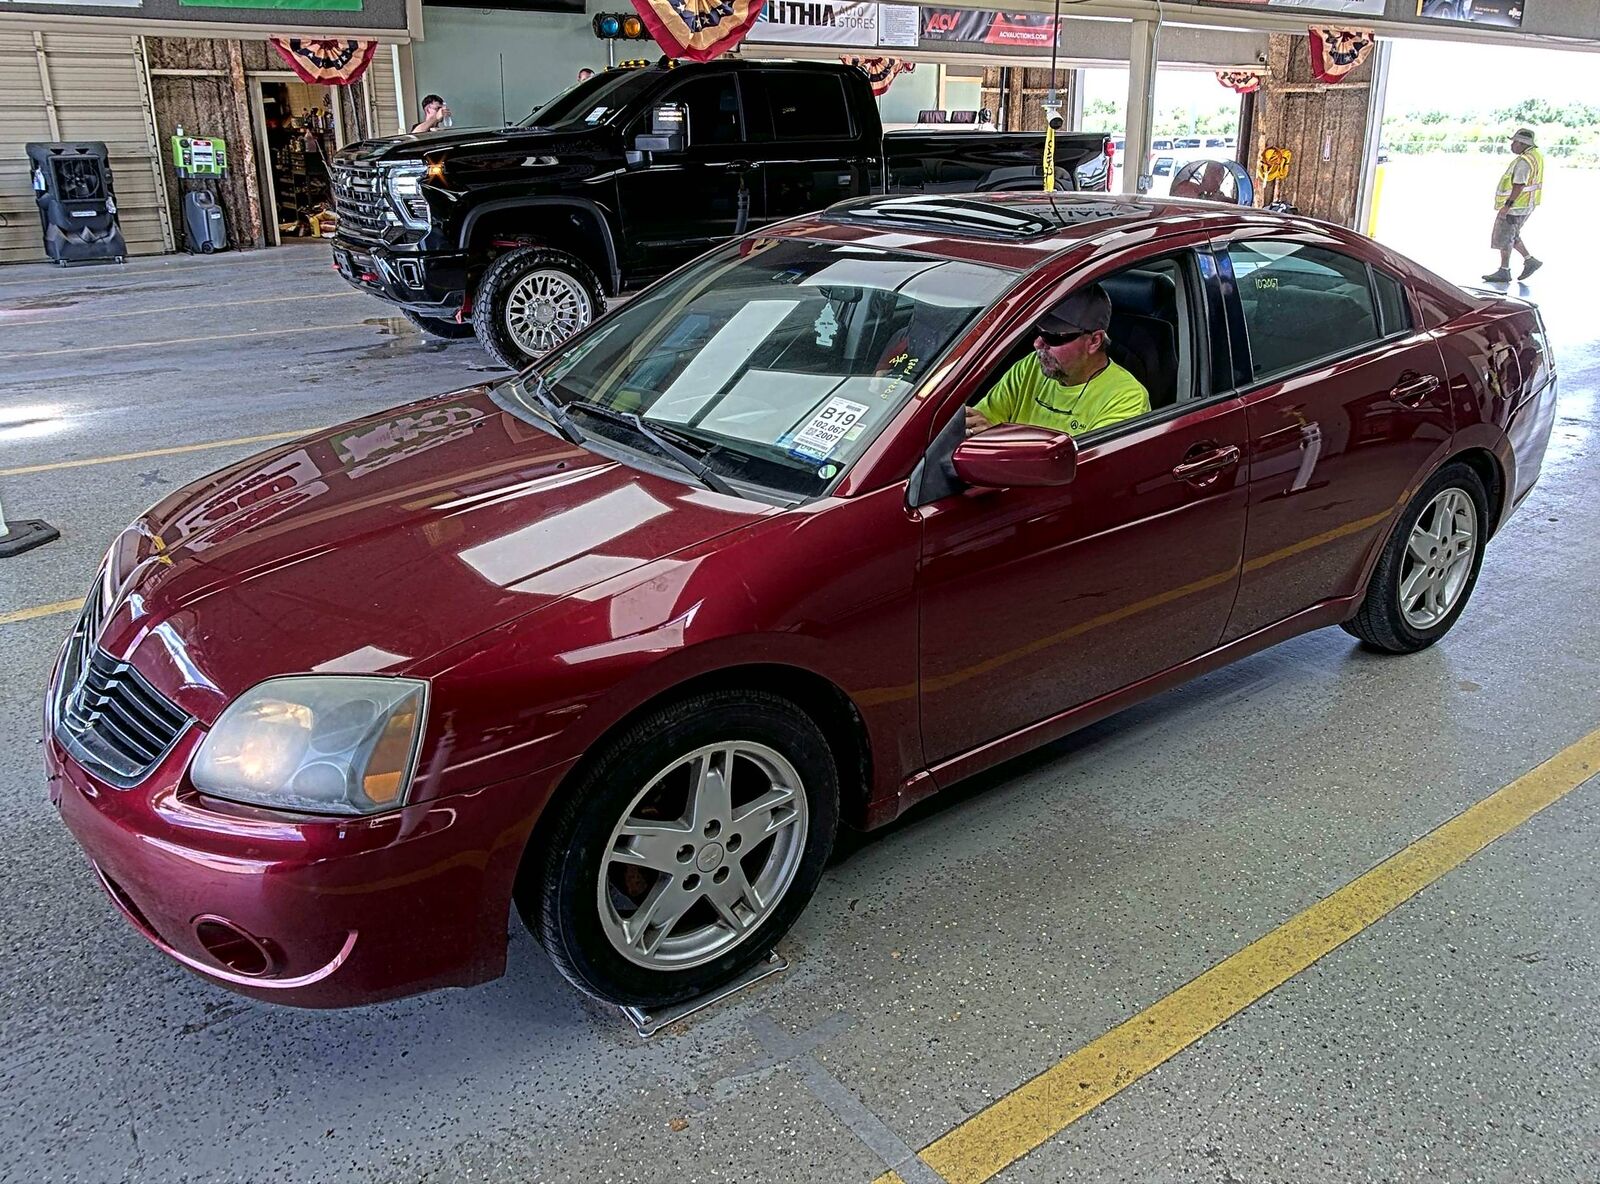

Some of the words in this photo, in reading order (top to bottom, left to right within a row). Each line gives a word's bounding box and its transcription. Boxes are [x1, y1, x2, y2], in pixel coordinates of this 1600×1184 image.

[768, 1, 836, 27] LITHIA
[840, 5, 864, 17] AUTO
[838, 17, 875, 30] STORES
[820, 407, 856, 426] B19
[815, 430, 839, 443] 2007
